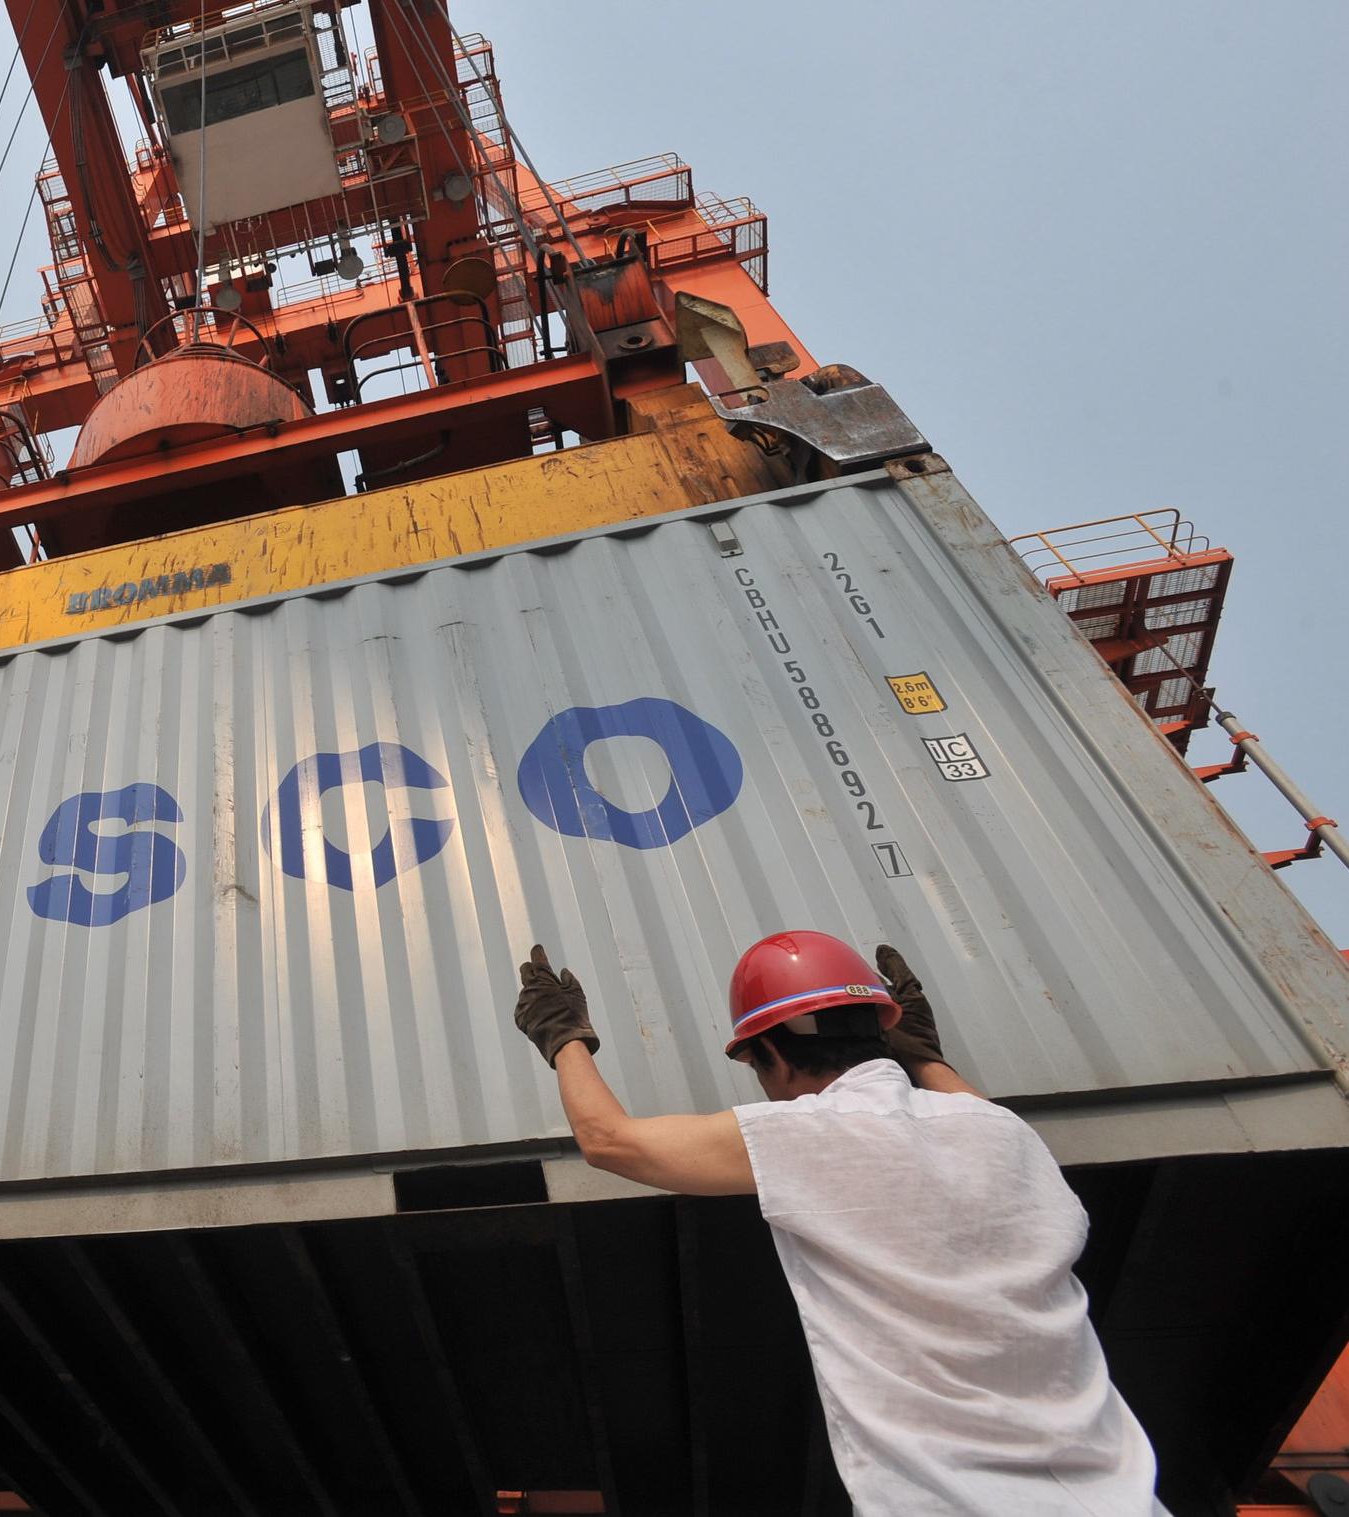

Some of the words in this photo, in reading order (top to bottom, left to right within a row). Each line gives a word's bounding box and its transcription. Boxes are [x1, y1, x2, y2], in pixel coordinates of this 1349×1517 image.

[822, 552, 885, 638] 22G1
[892, 681, 930, 695] 2,6m
[733, 567, 792, 655] CBHU
[783, 659, 884, 831] 588692
[877, 844, 901, 875] 7
[946, 762, 978, 778] 33
